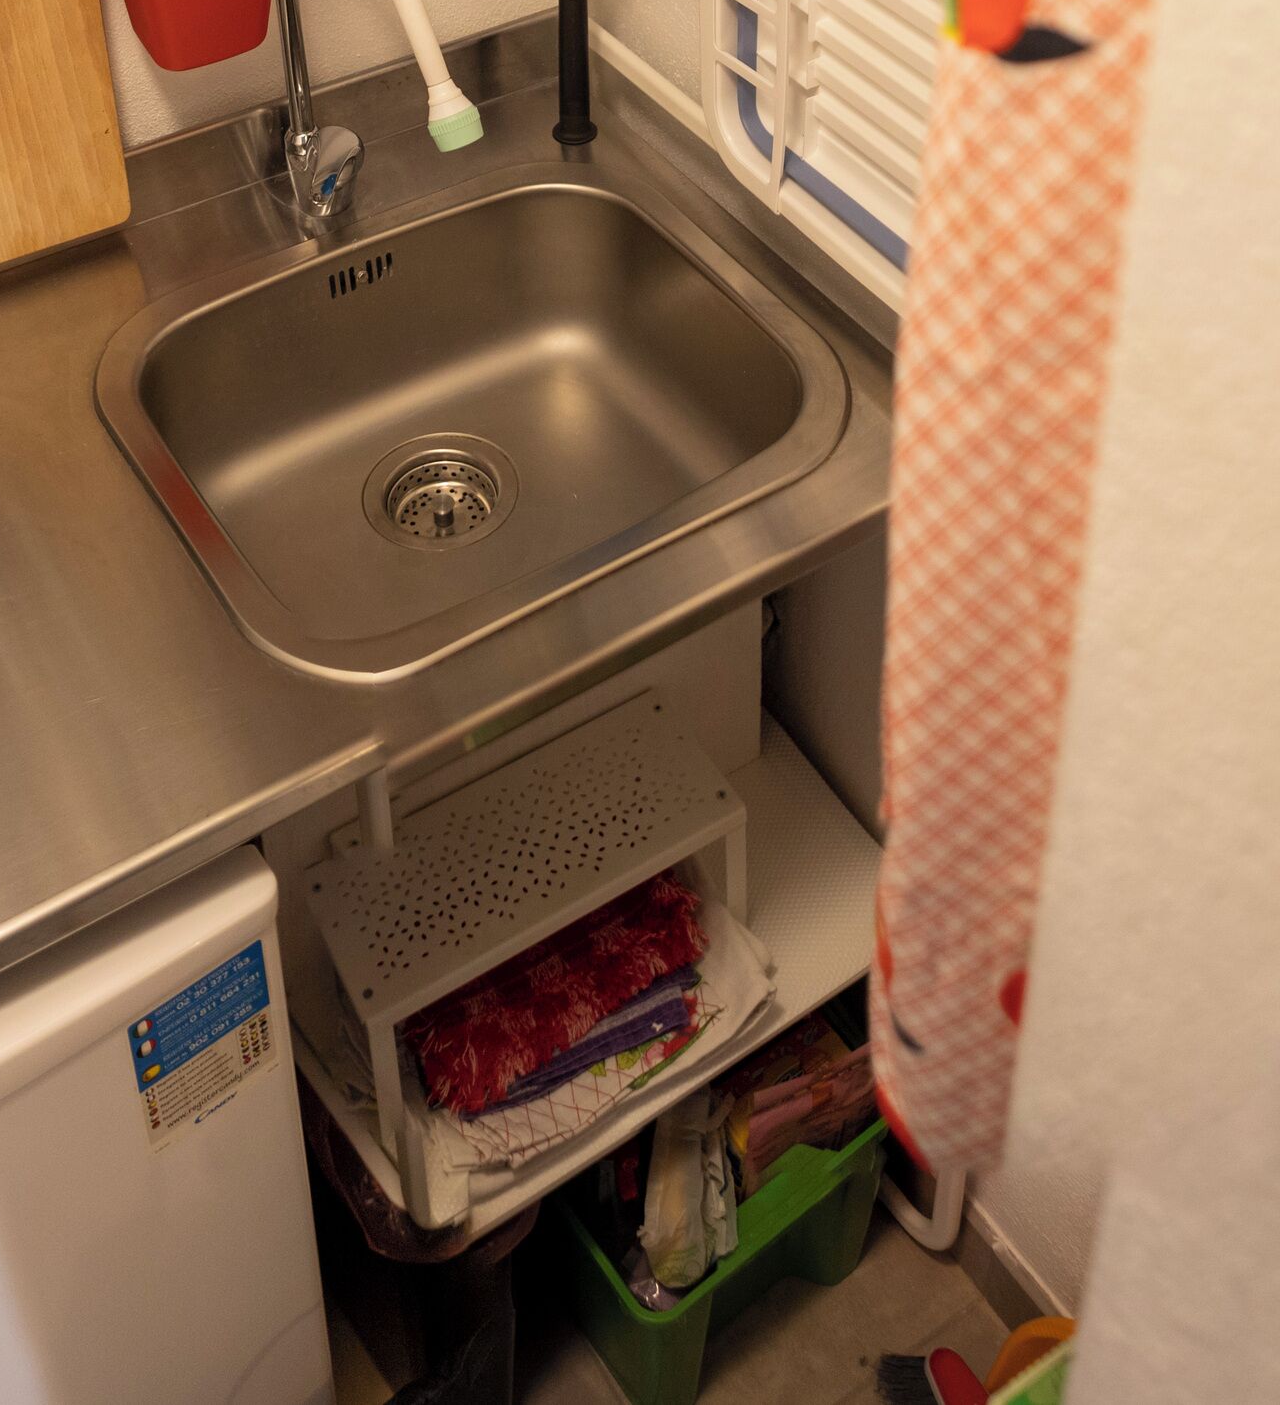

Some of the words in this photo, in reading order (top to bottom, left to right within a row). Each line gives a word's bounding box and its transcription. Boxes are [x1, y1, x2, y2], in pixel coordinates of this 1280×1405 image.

[175, 996, 189, 1011] 02
[193, 984, 206, 998] 30
[210, 970, 227, 987] 377
[188, 1033, 208, 1052] 902
